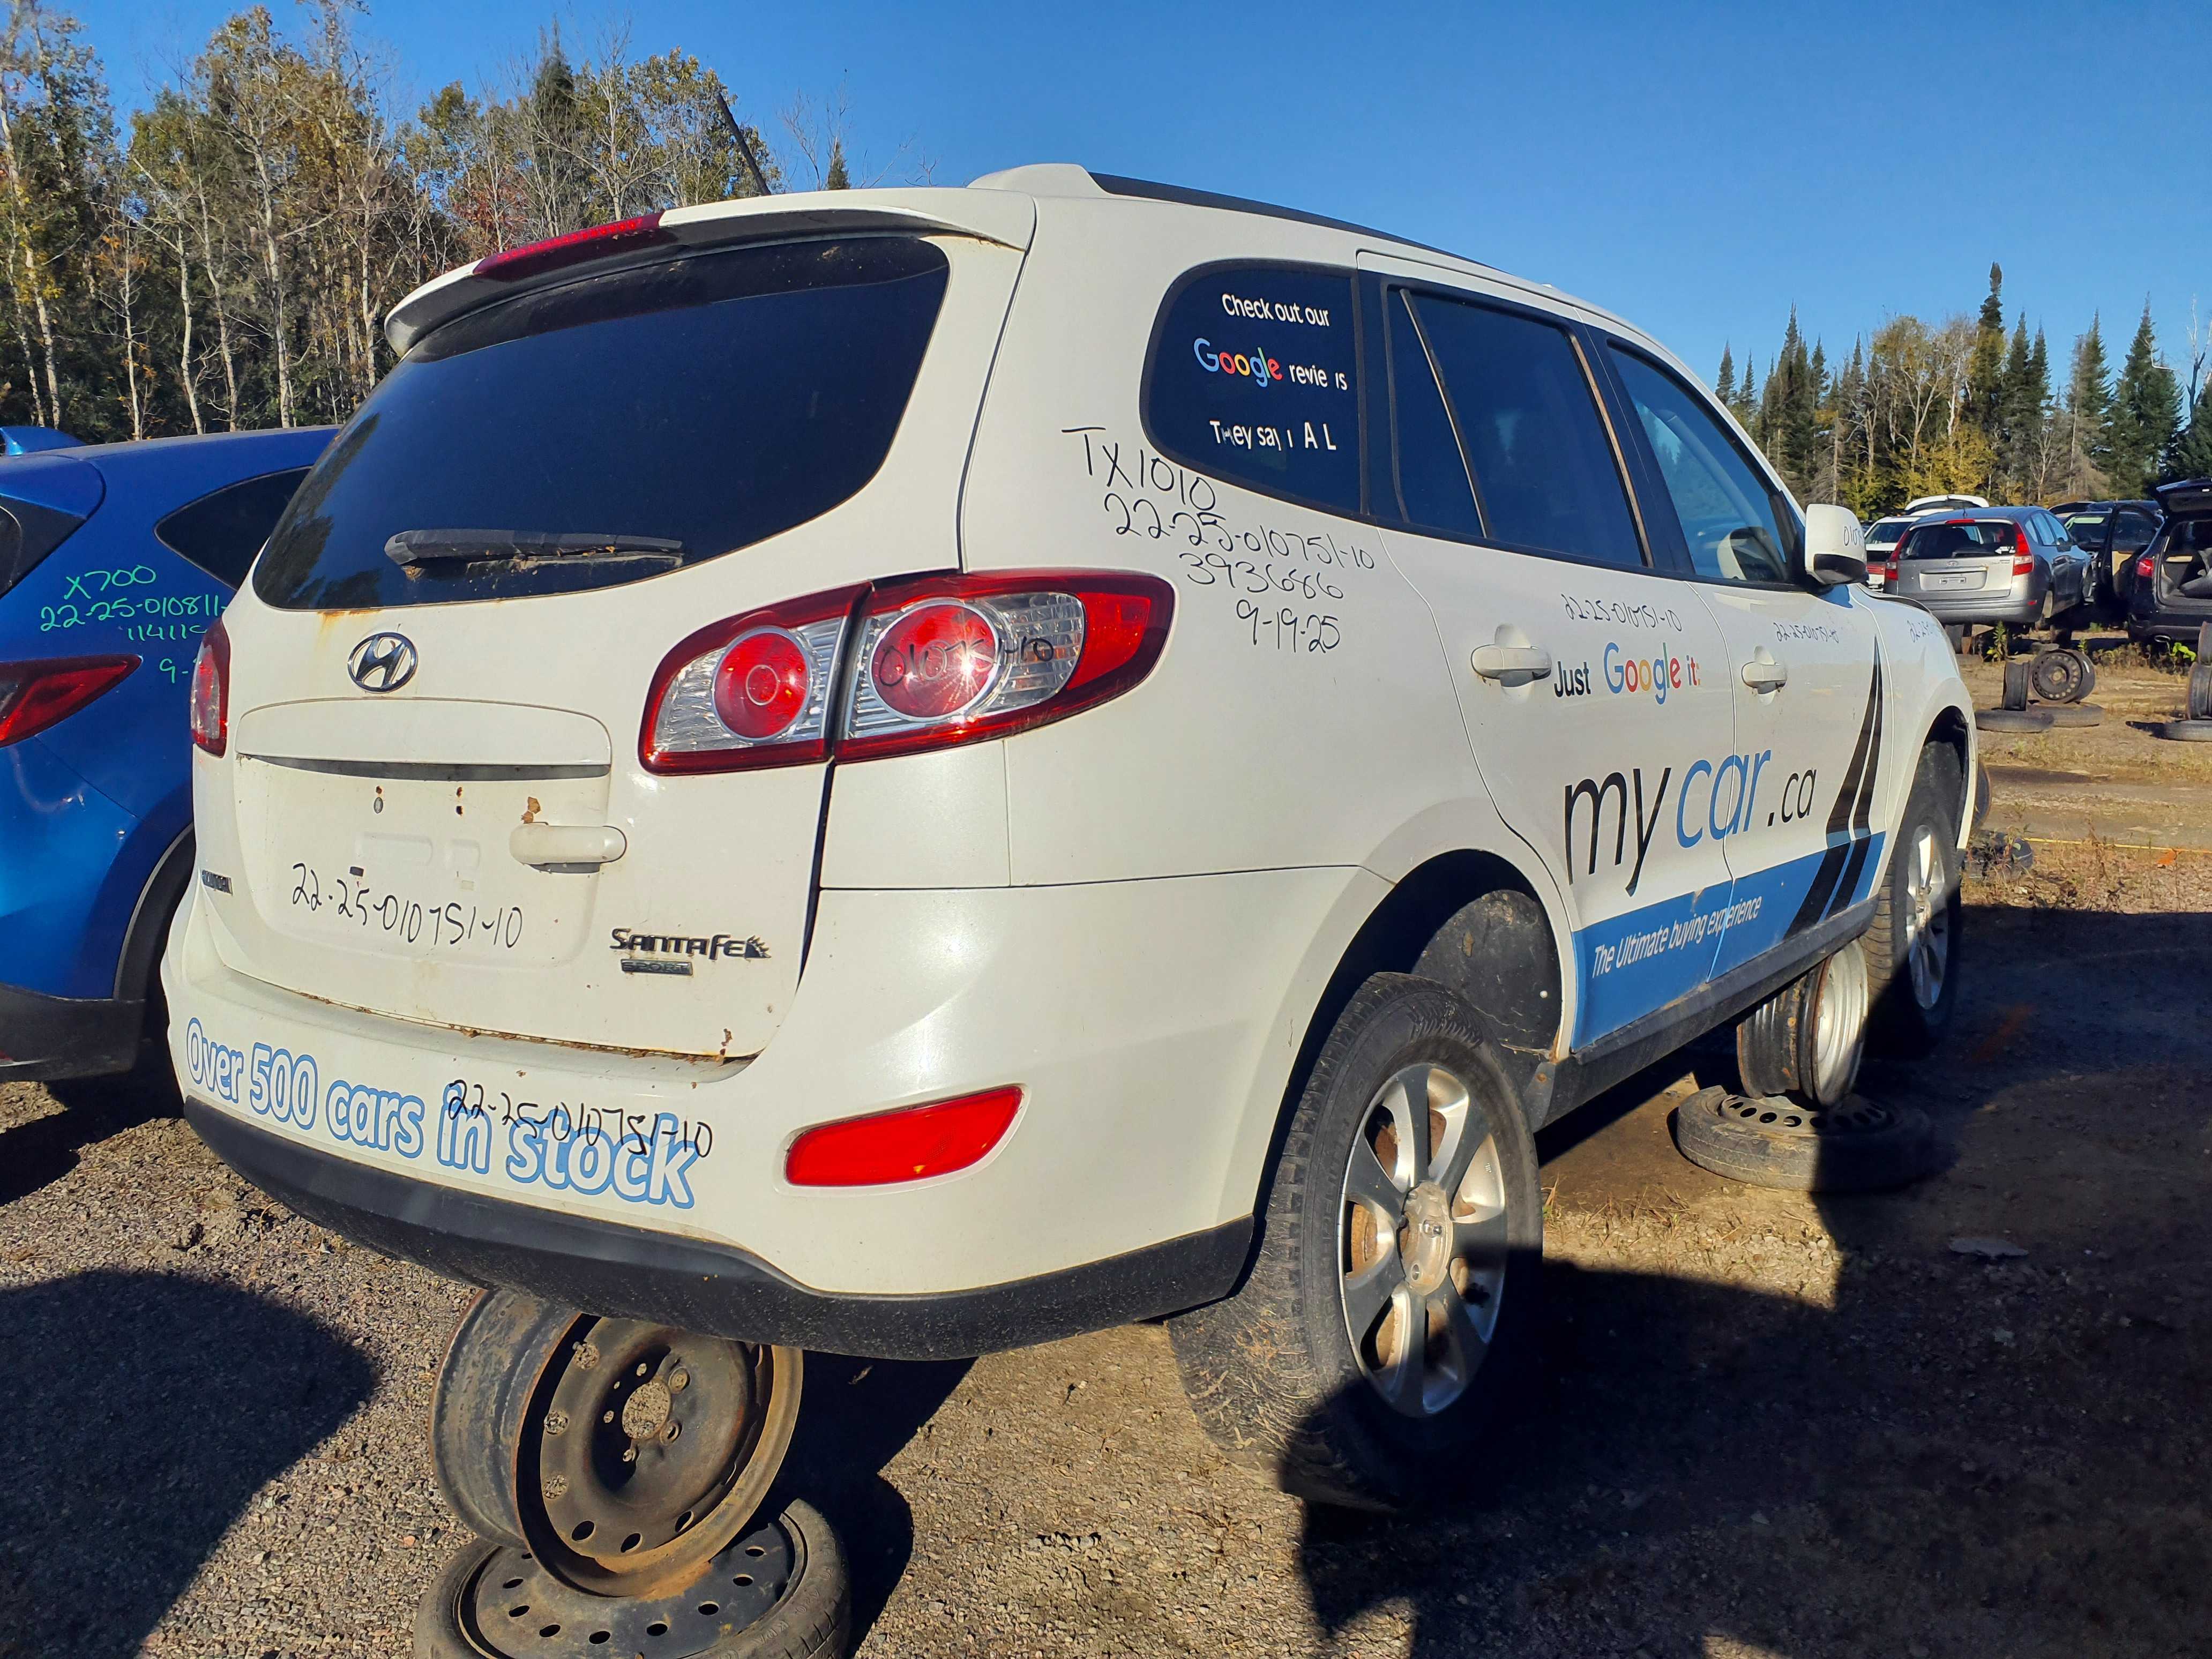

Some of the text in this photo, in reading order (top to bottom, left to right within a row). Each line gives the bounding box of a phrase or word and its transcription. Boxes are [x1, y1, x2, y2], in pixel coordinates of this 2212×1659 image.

[1222, 293, 1330, 326] Check out our
[1194, 337, 1283, 387] Google
[64, 565, 156, 600] X700
[1554, 661, 1590, 697] Just
[1604, 642, 1681, 704] Google
[1592, 896, 1762, 978] The Ultimate buying experience
[187, 1017, 699, 1209] Over 500 cars in stock
